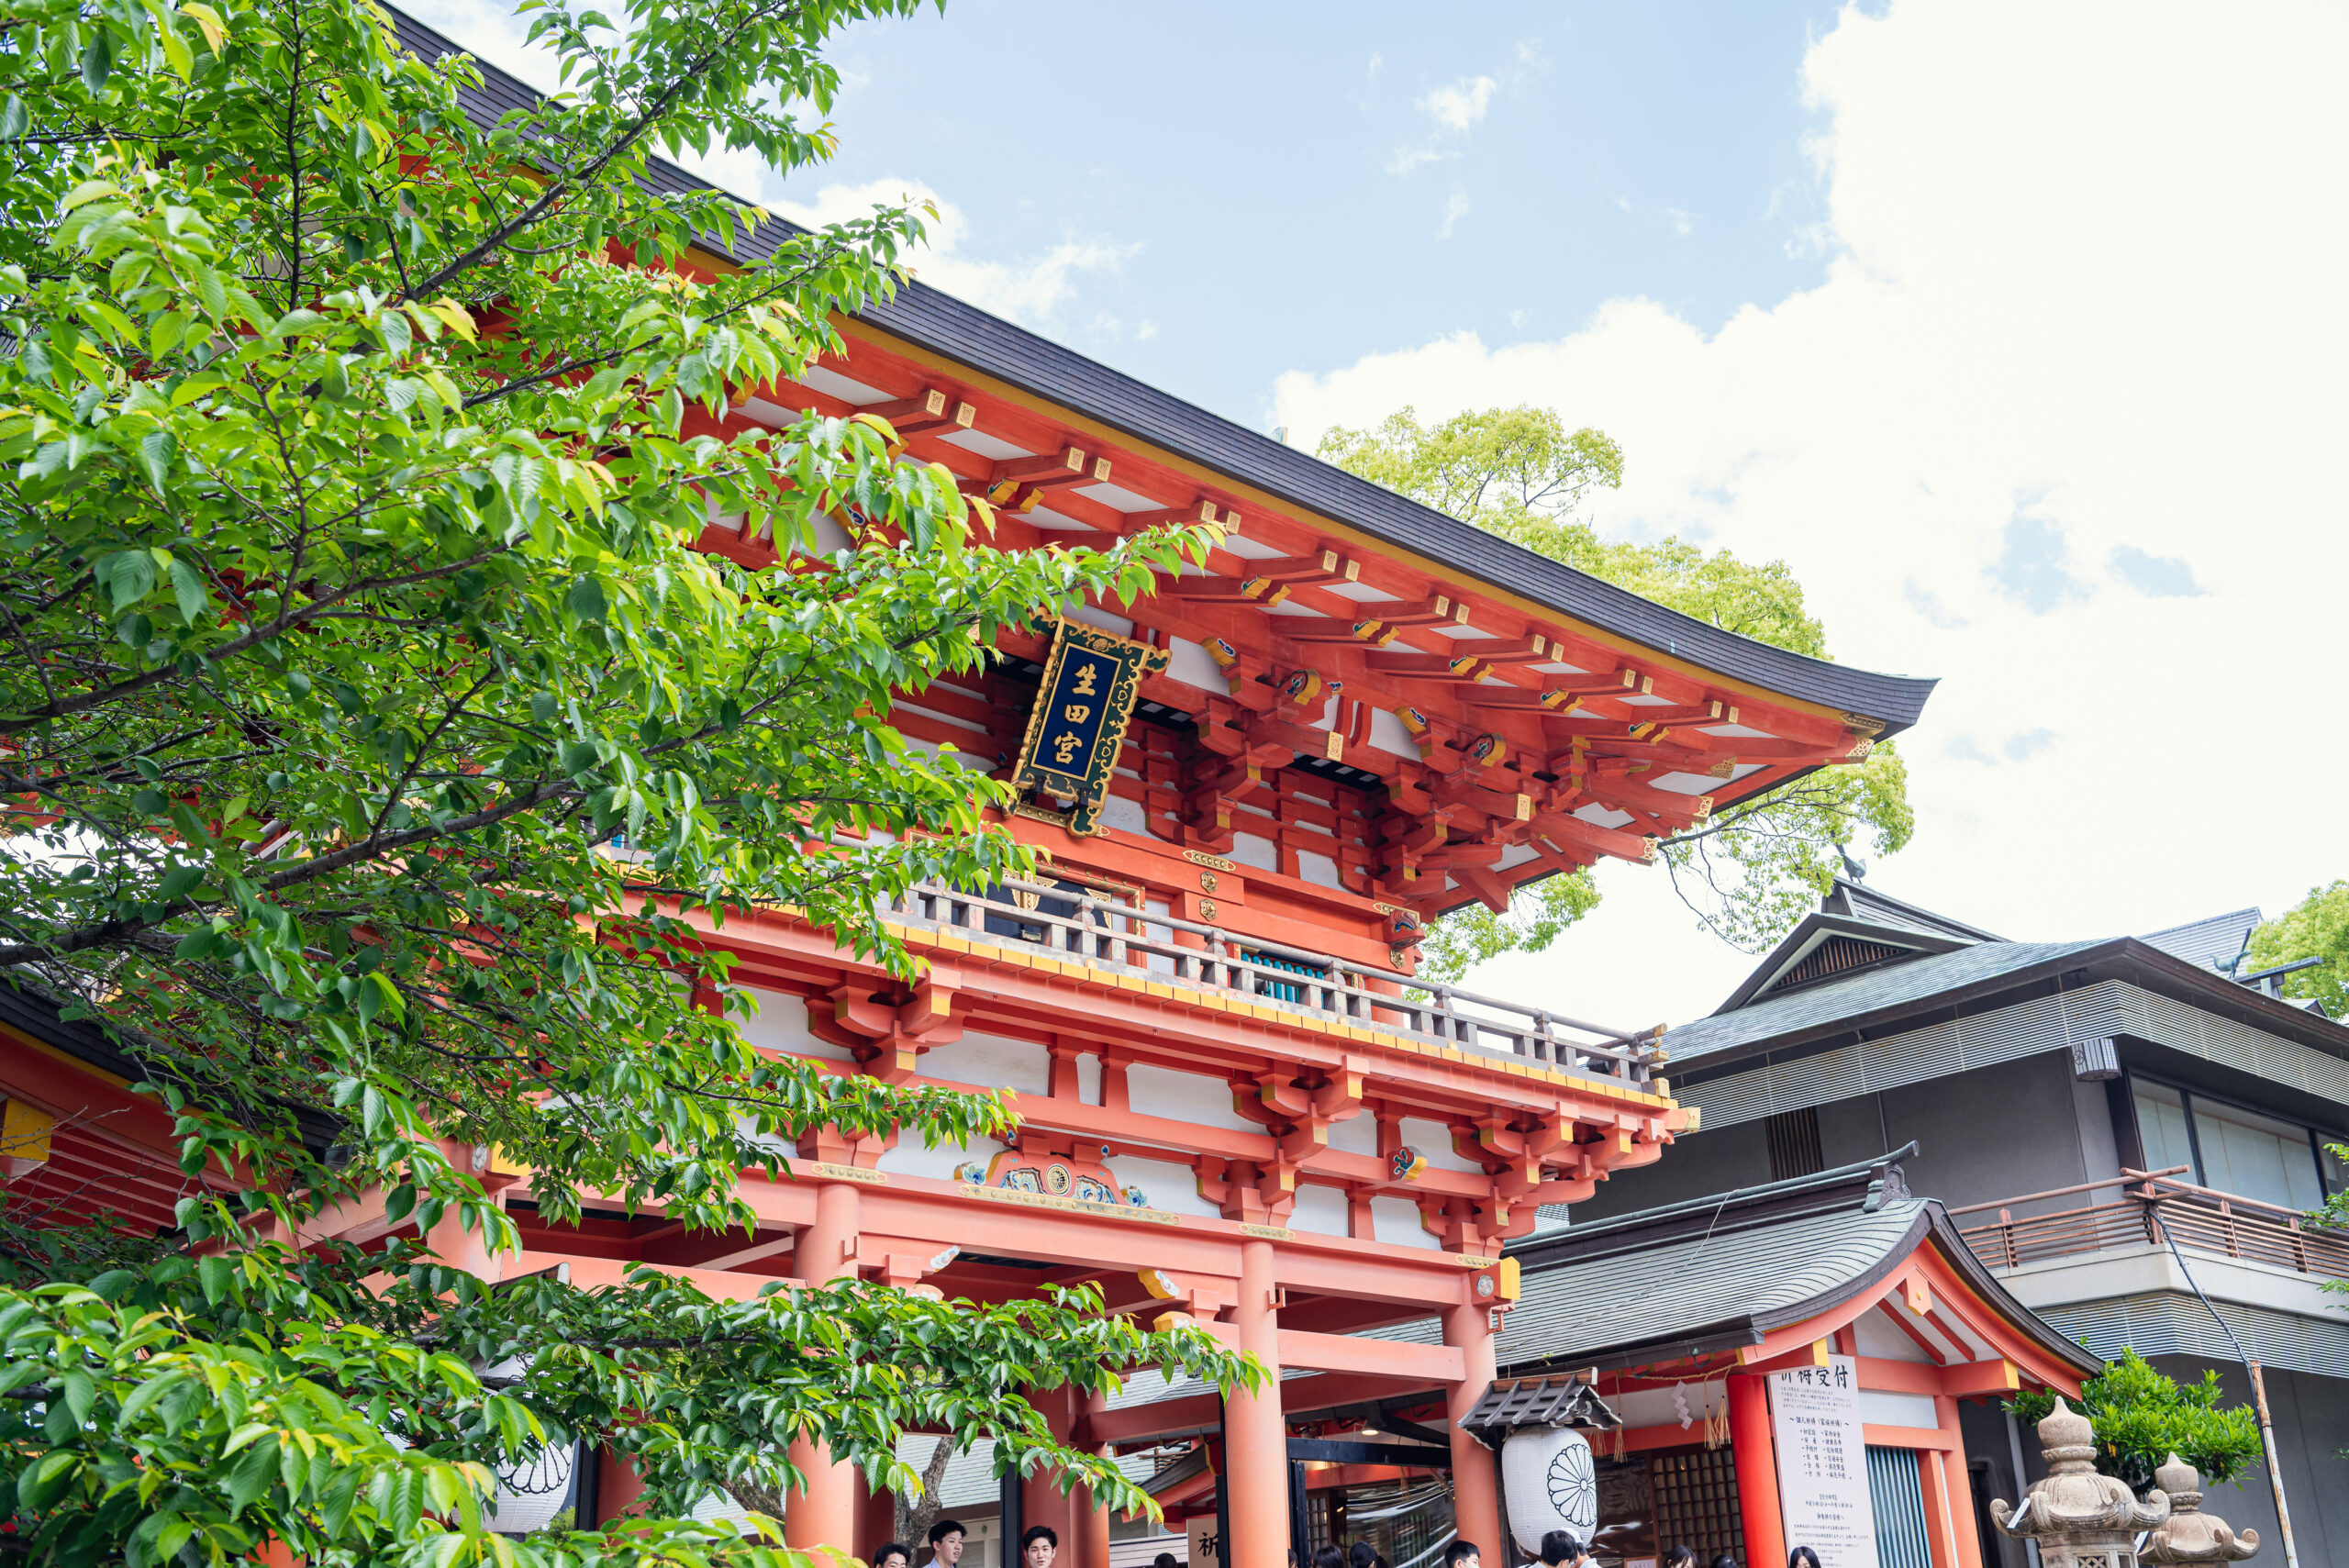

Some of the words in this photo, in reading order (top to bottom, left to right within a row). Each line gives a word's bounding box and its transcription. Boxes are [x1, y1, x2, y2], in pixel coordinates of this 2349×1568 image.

[1054, 663, 1097, 764] 生田宮
[1197, 1532, 1219, 1558] 祈
